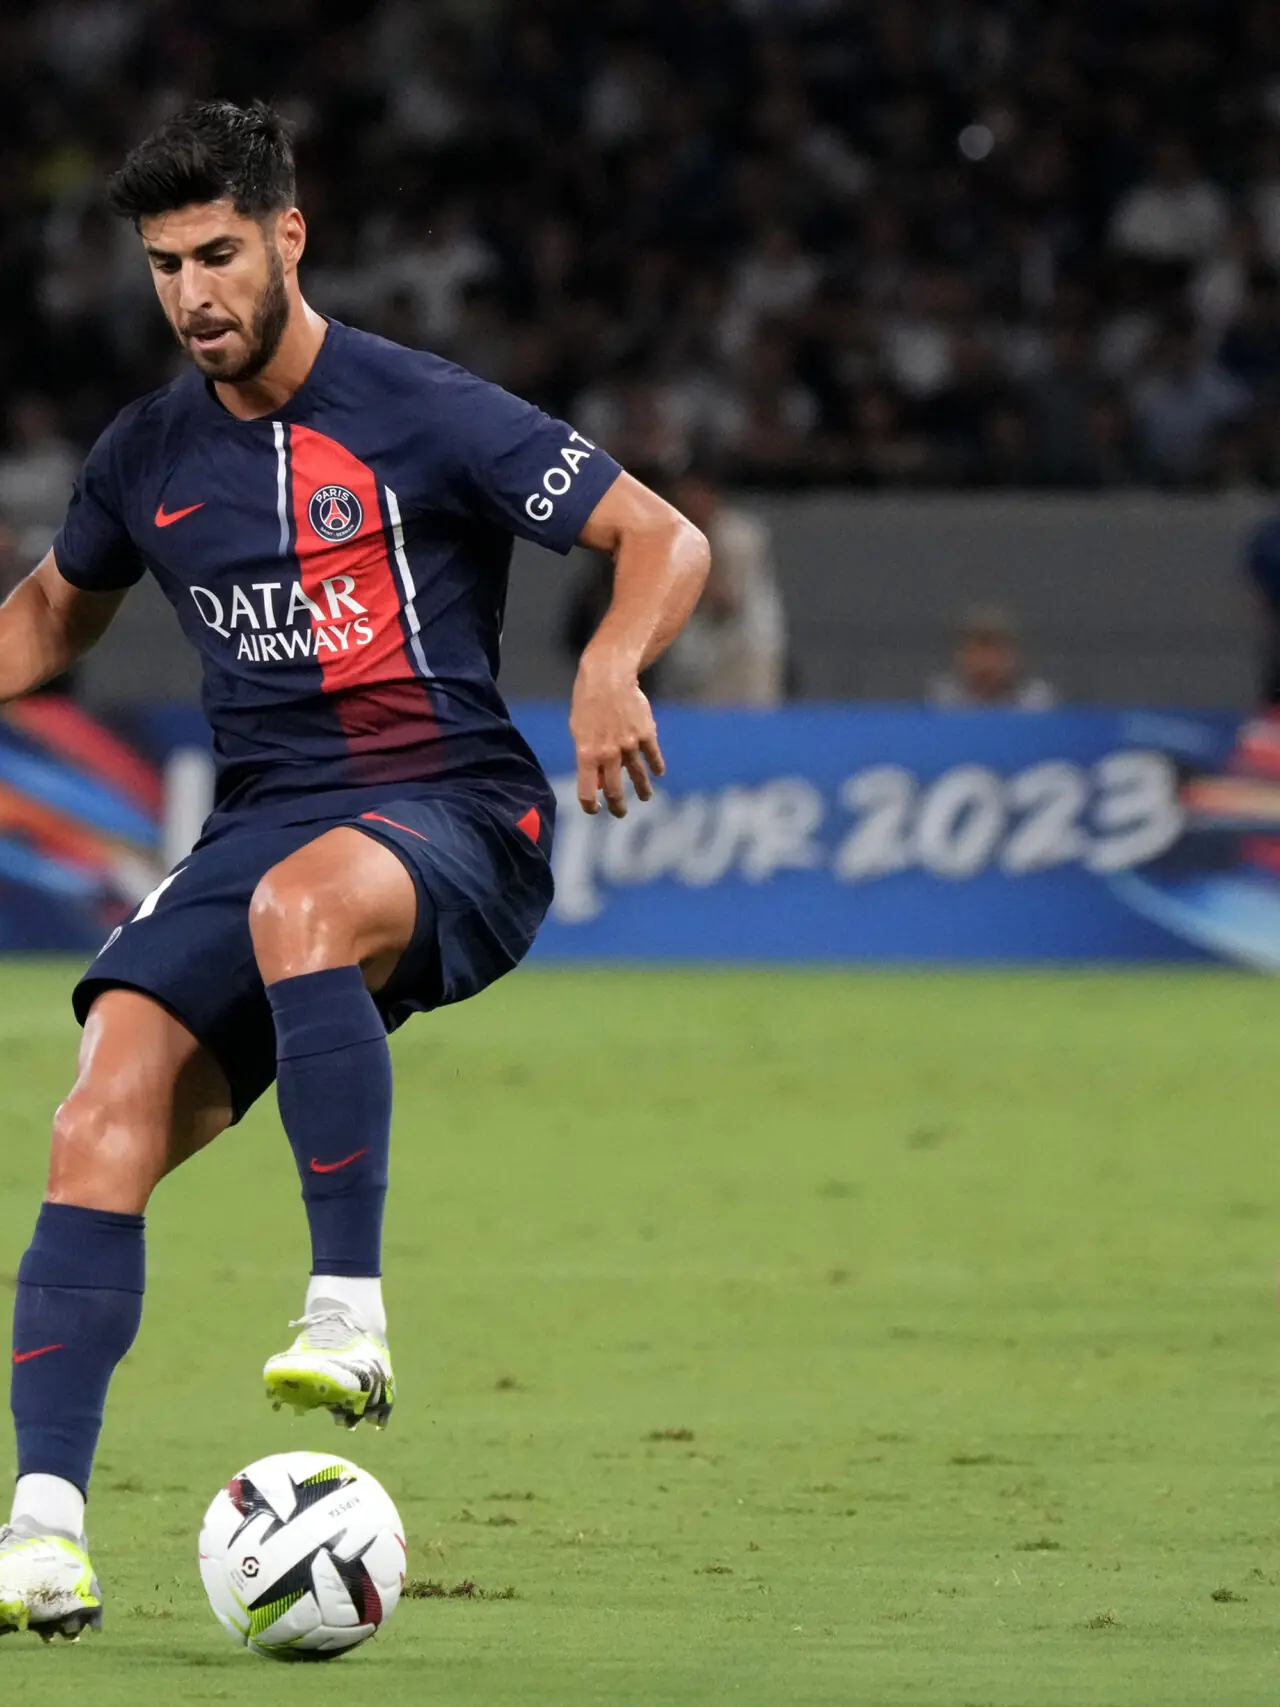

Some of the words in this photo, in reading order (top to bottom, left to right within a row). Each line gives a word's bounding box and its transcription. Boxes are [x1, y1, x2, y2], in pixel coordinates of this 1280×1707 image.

[315, 488, 350, 504] PARIS
[525, 431, 595, 521] GOAT
[189, 575, 368, 639] QATAR
[237, 617, 373, 662] AIRWAYS
[834, 748, 1186, 883] 2023
